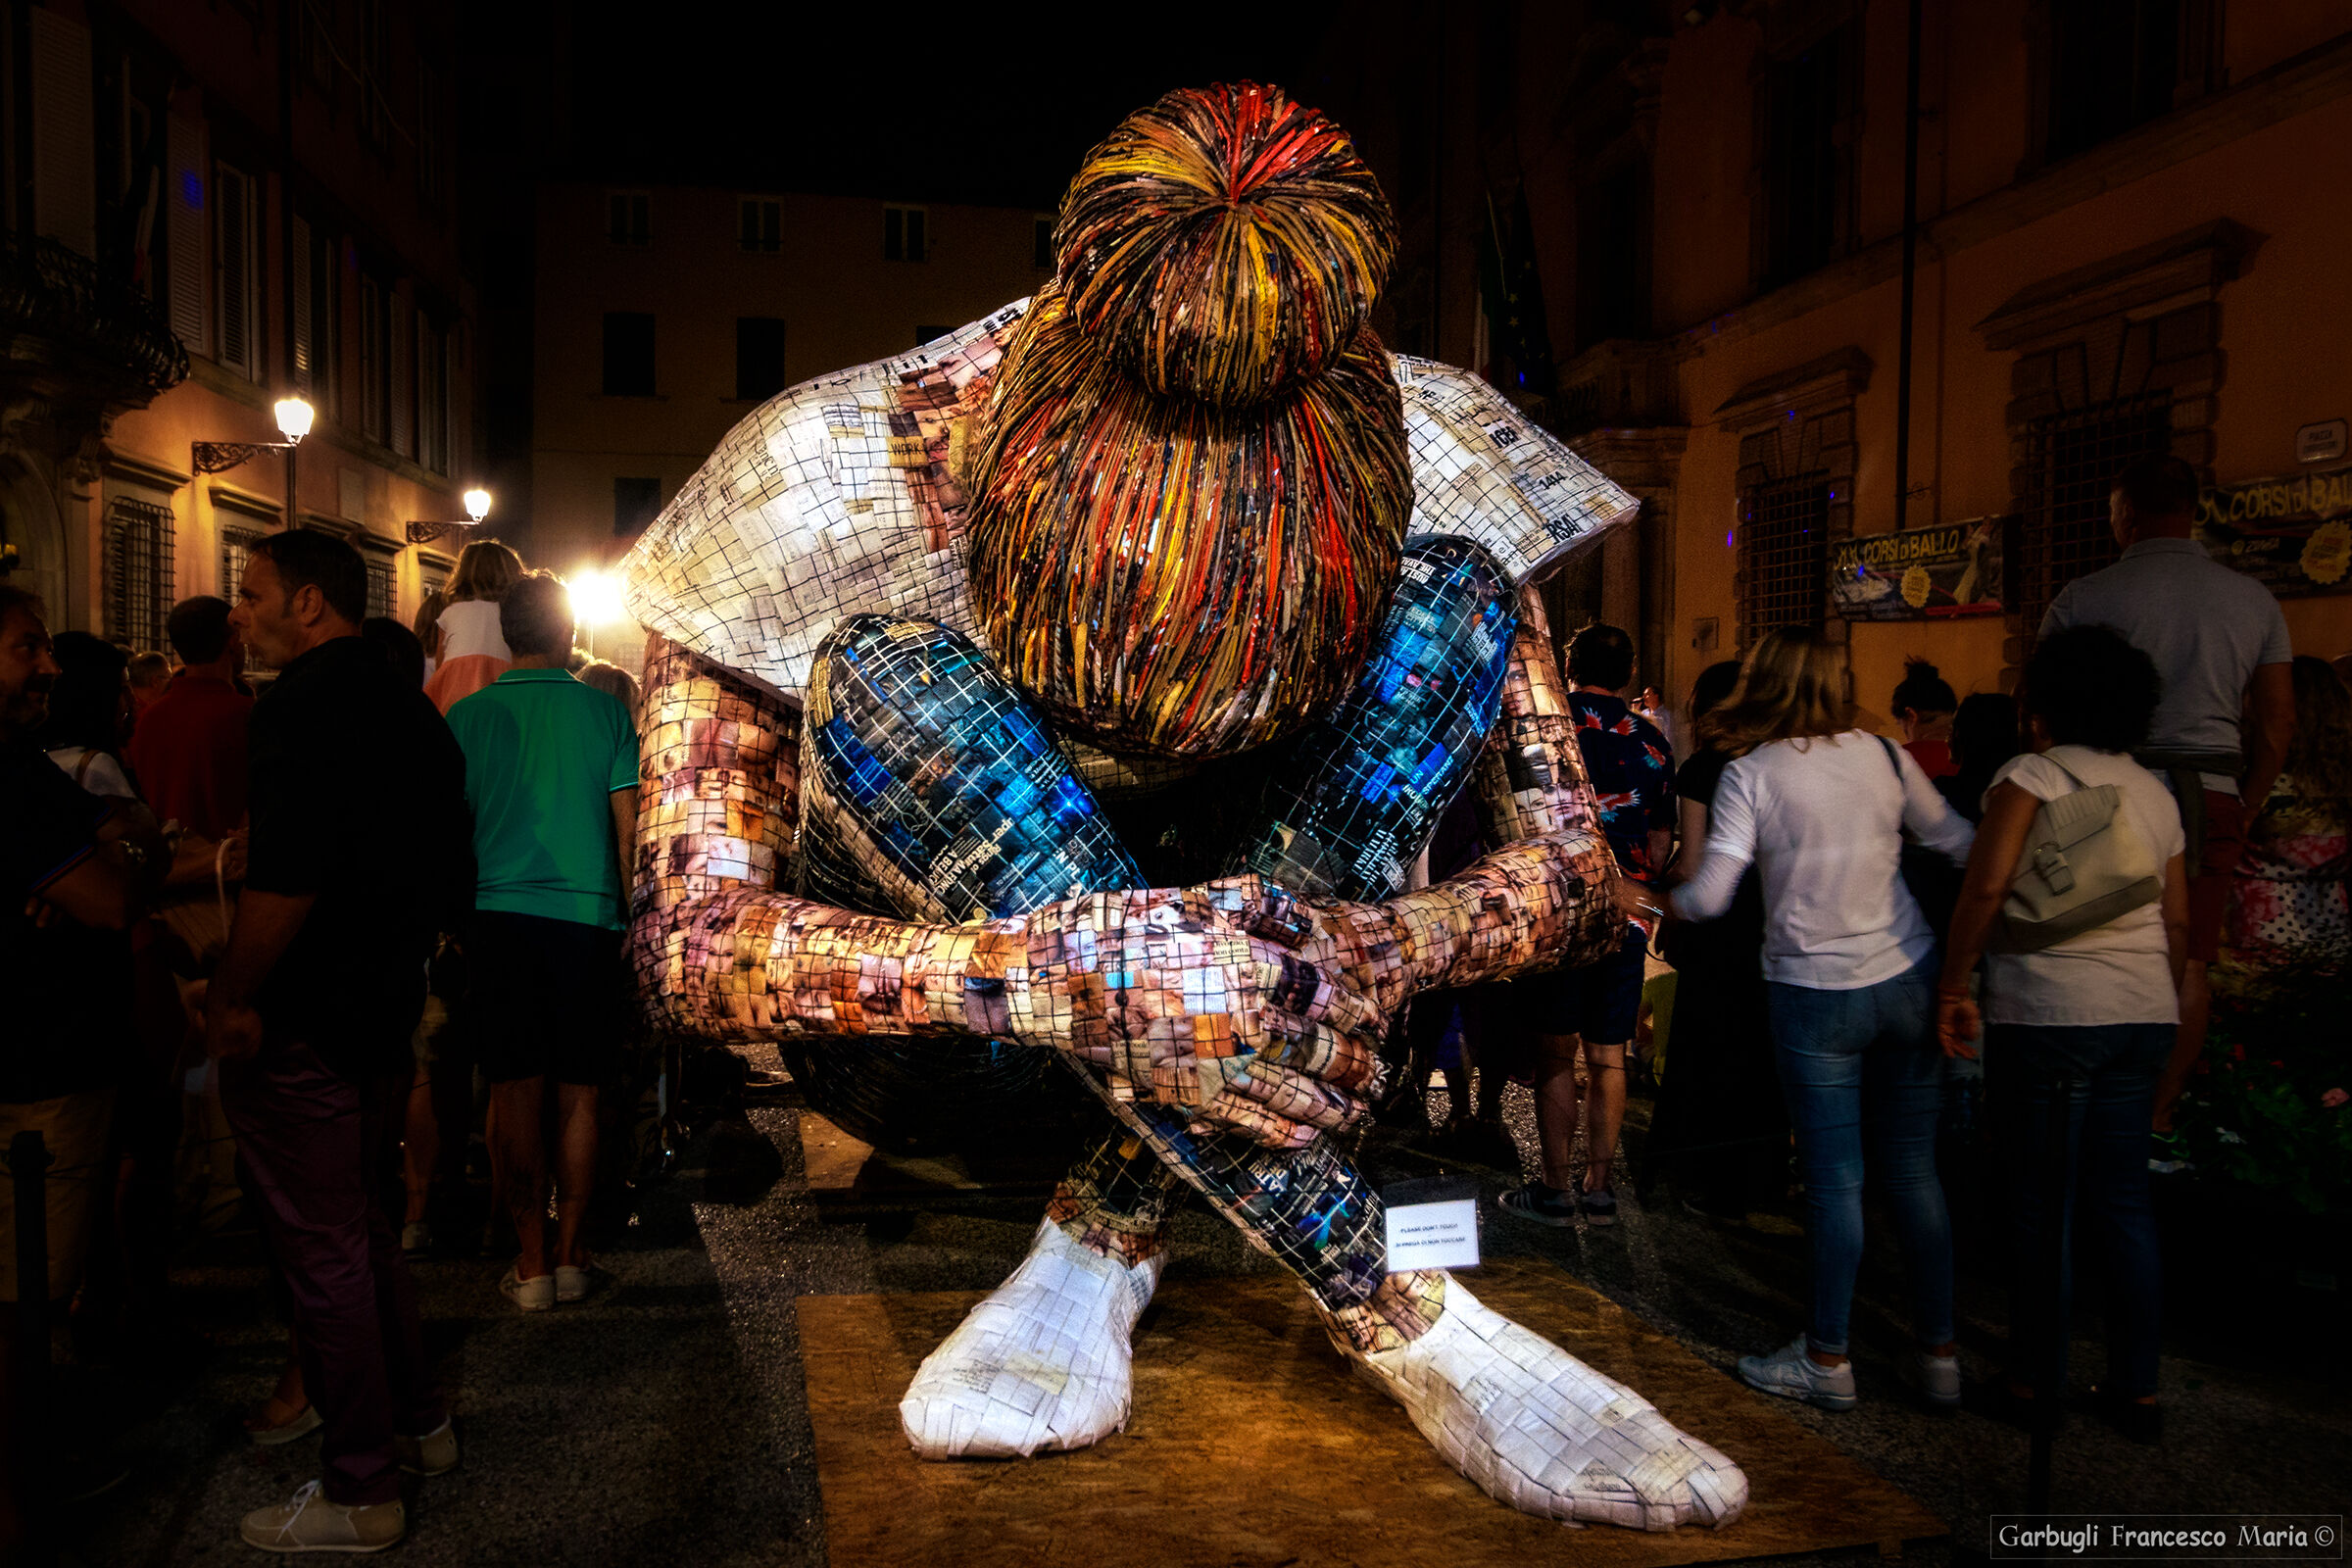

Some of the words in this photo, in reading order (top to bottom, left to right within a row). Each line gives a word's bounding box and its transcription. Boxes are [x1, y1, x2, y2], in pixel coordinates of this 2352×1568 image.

[891, 442, 923, 455] WORK
[2230, 484, 2290, 521] CORSI
[1864, 538, 1899, 564] CORSI
[1910, 529, 1959, 559] BALLO
